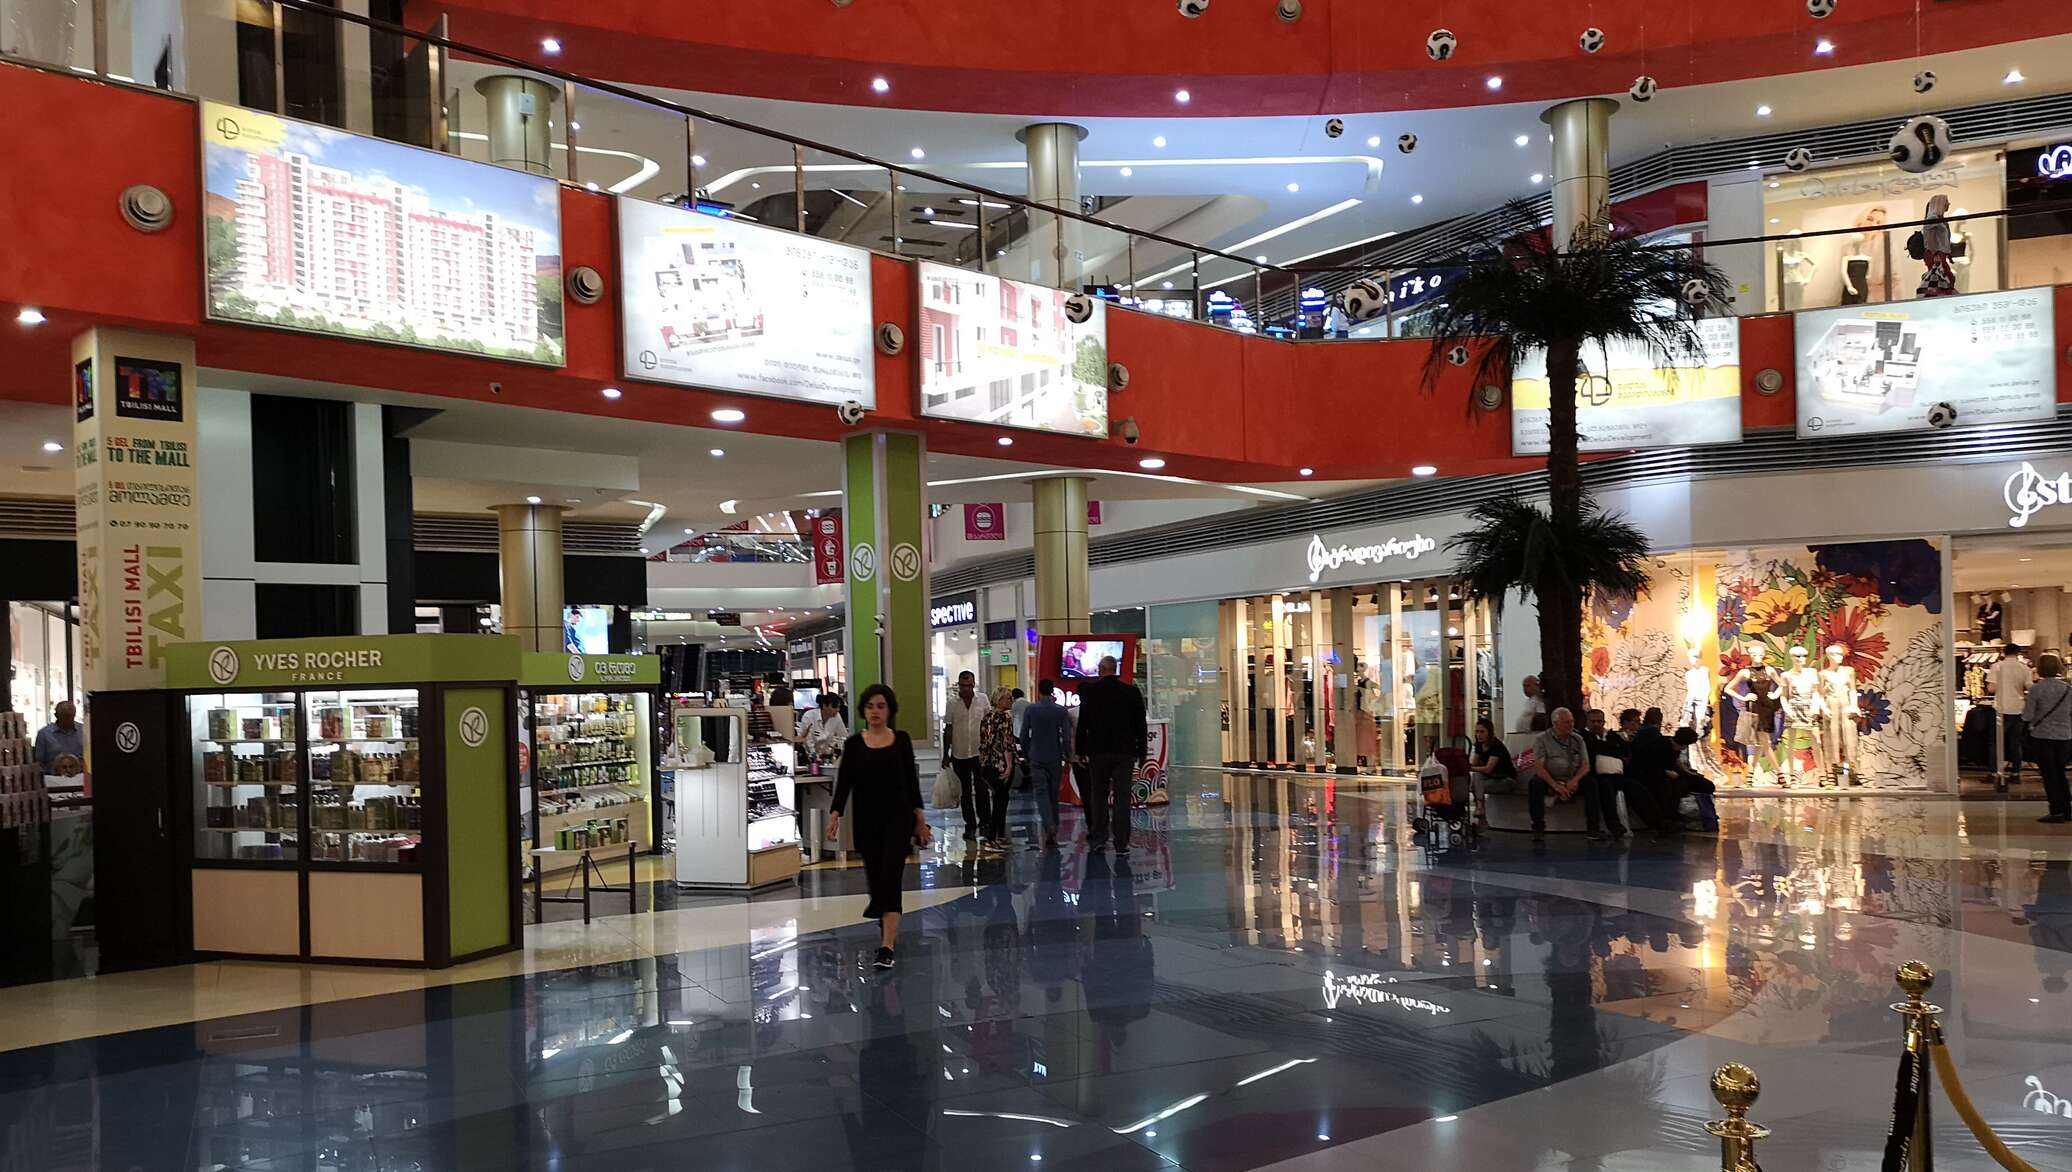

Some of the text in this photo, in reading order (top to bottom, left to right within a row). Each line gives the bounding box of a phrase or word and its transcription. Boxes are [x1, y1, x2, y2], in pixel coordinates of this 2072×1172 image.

[153, 402, 178, 414] MALL
[132, 438, 156, 450] FROM
[160, 440, 188, 452] TBILISI
[107, 446, 124, 464] TO
[128, 448, 152, 465] THE
[155, 450, 191, 468] MALL
[108, 489, 191, 507] მოლამდე
[124, 544, 143, 669] TBILISI MALL
[146, 546, 186, 670] TAXI
[253, 650, 383, 671] YVES ROCHER
[291, 671, 344, 682] FRANCE
